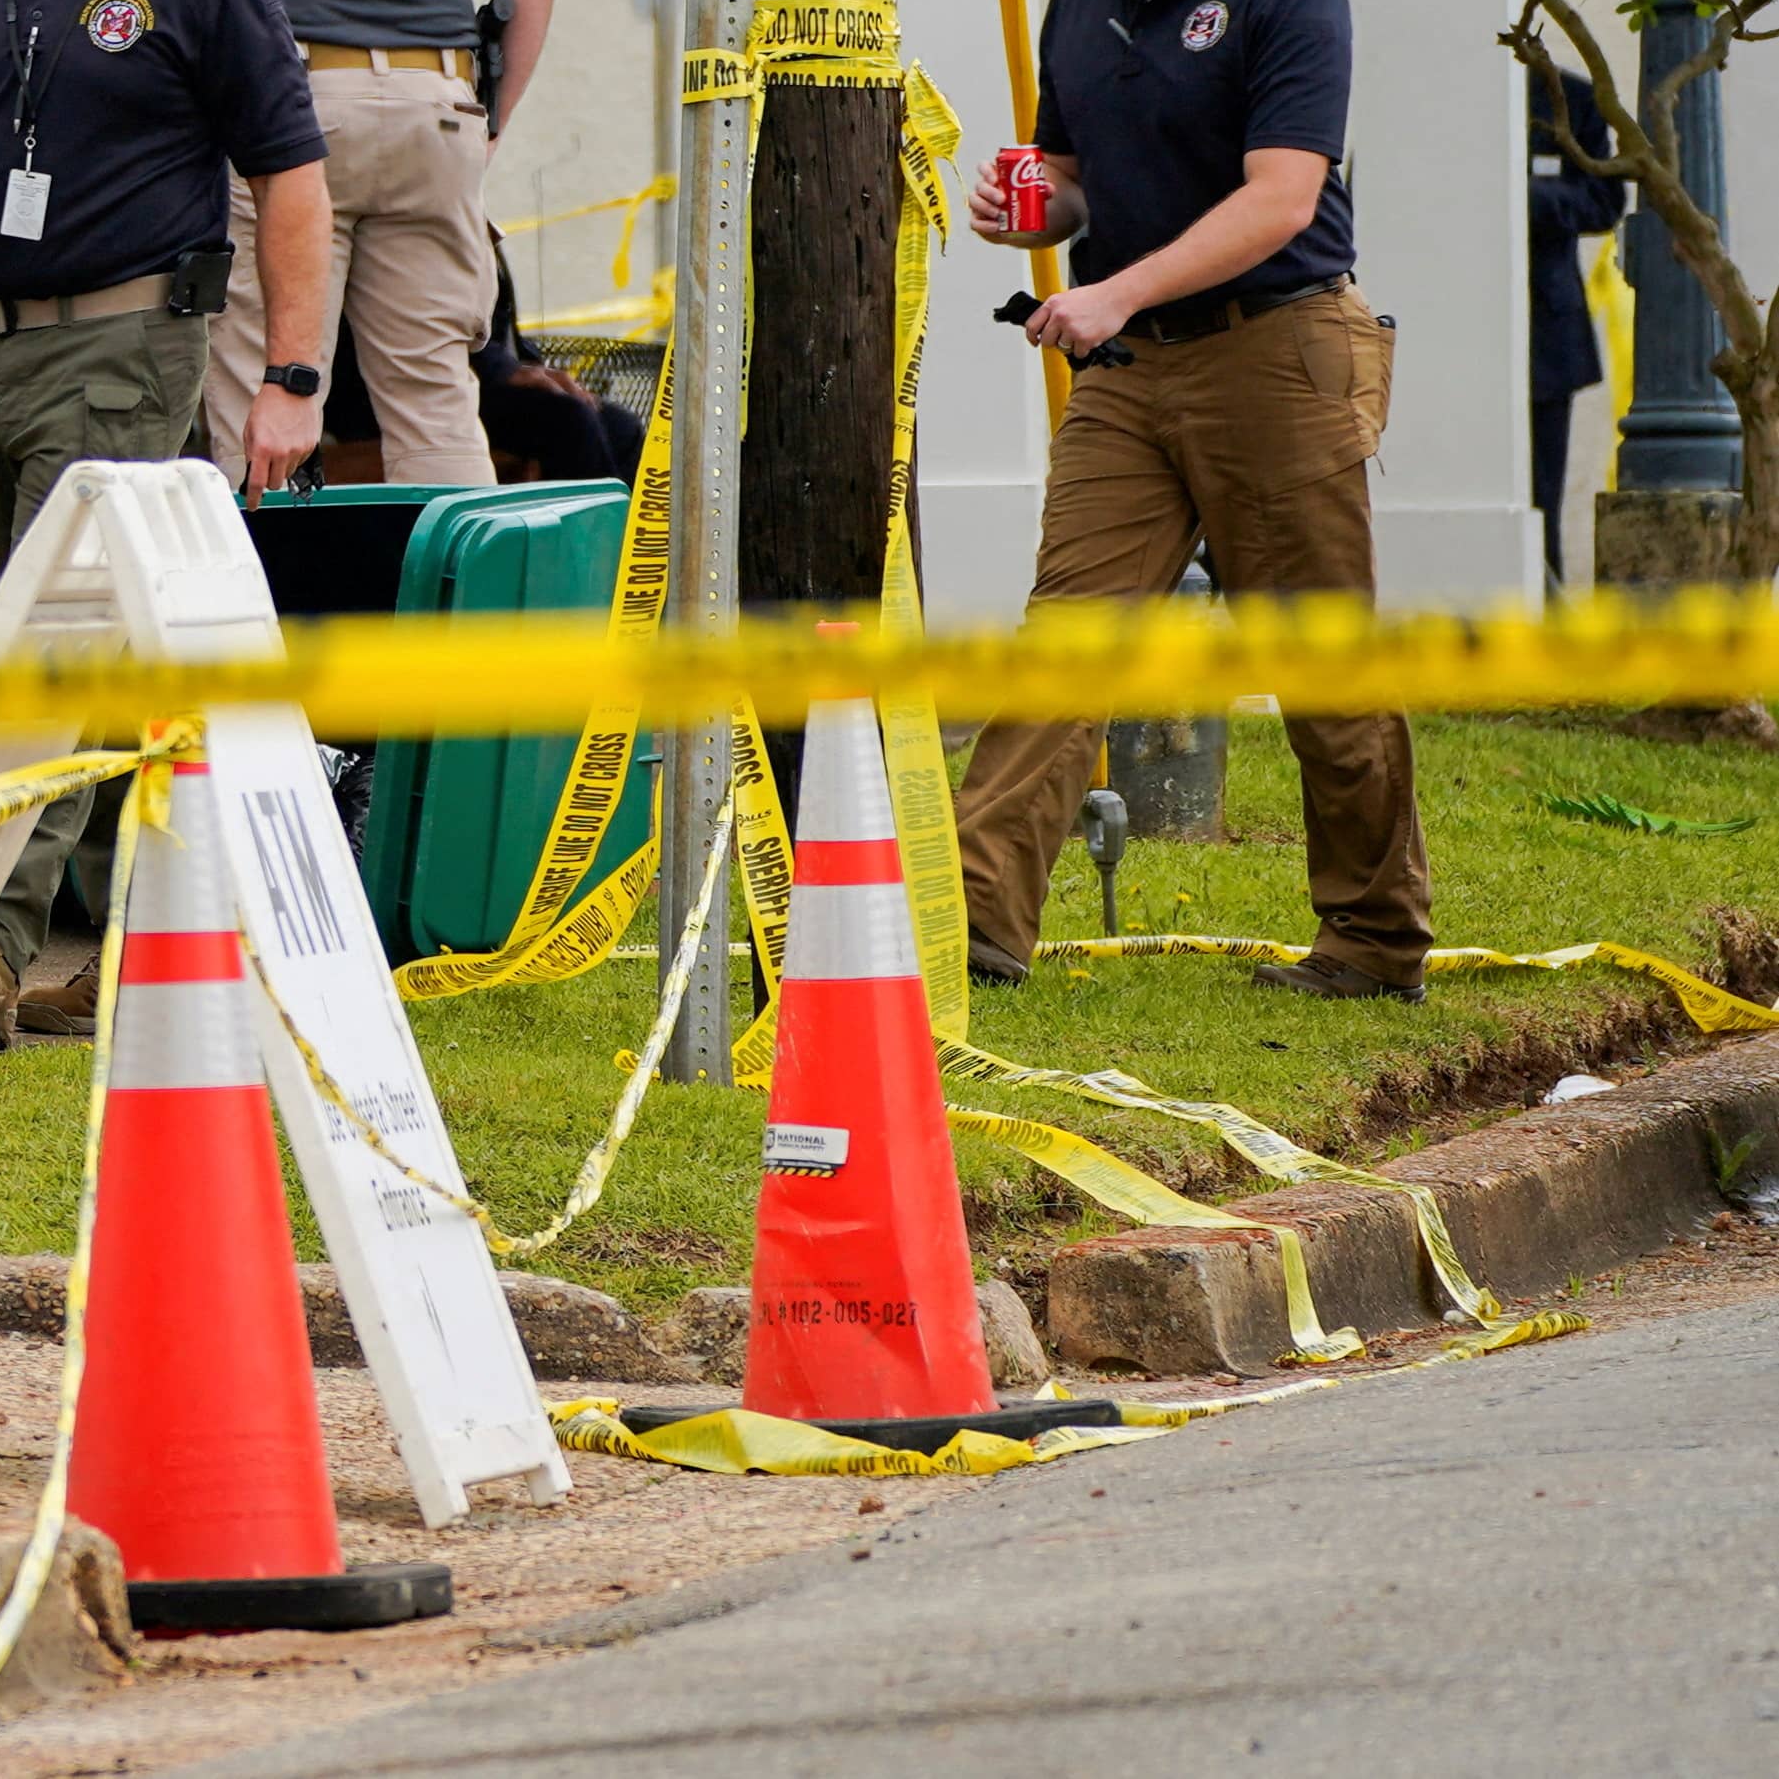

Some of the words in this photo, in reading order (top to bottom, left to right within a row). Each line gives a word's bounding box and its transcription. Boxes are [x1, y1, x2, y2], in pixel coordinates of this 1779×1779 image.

[795, 7, 829, 46] NOT
[834, 8, 884, 52] CROSS
[632, 527, 670, 558] NOT
[628, 563, 668, 585] DO
[579, 731, 628, 781] CROSS
[569, 783, 614, 813] NOT
[561, 814, 604, 833] DO
[550, 836, 596, 864] LINE
[241, 787, 347, 959] ATM
[530, 868, 582, 918] SHERIFF
[742, 836, 793, 916] SHERIFF
[566, 904, 614, 956] CRIME
